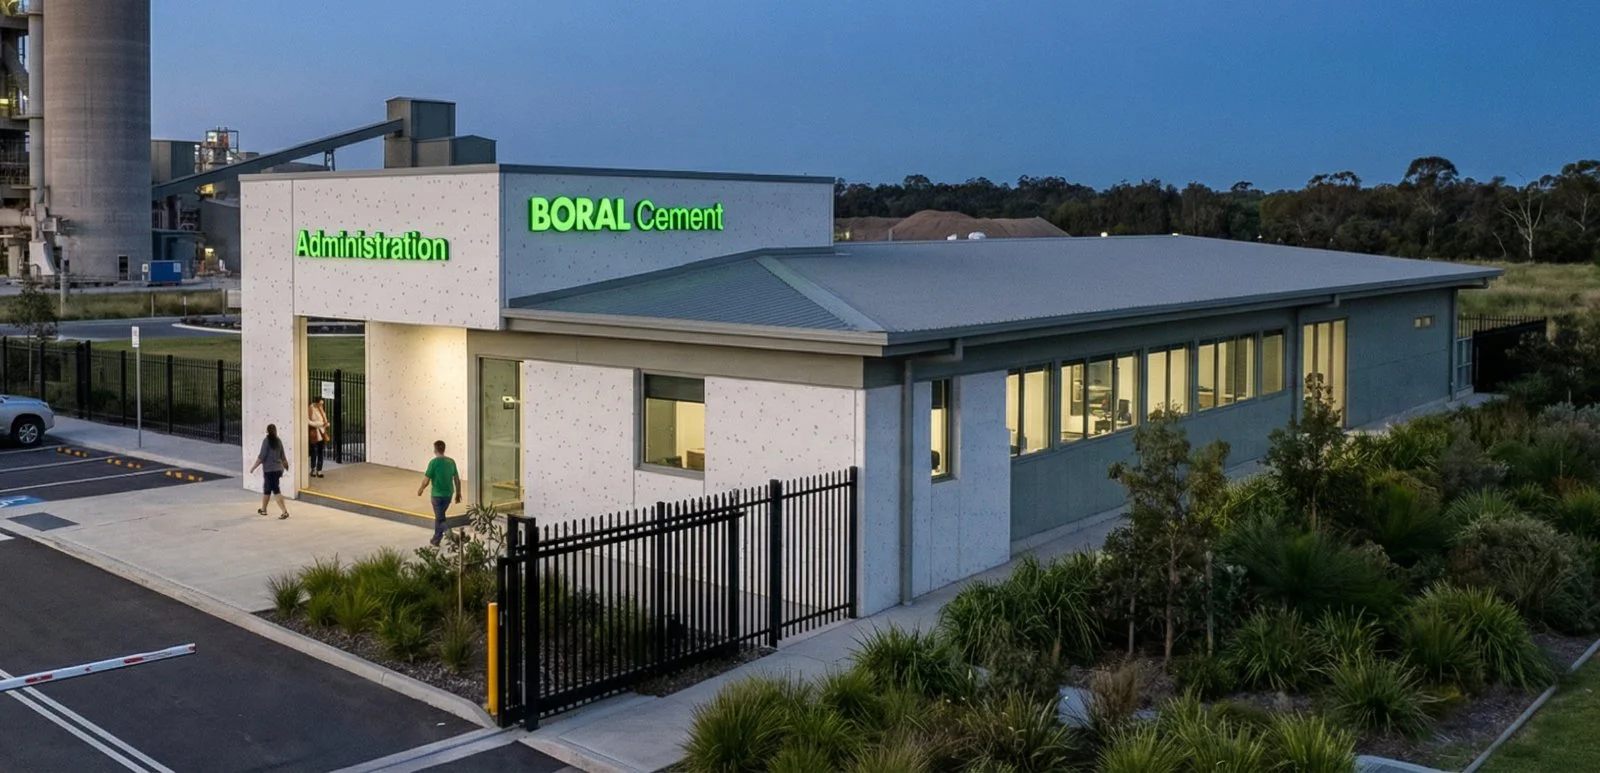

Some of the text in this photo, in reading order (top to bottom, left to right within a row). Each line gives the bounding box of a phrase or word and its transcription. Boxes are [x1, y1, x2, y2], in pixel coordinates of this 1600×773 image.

[530, 196, 724, 232] BORAL Cement
[296, 229, 449, 261] Administration
